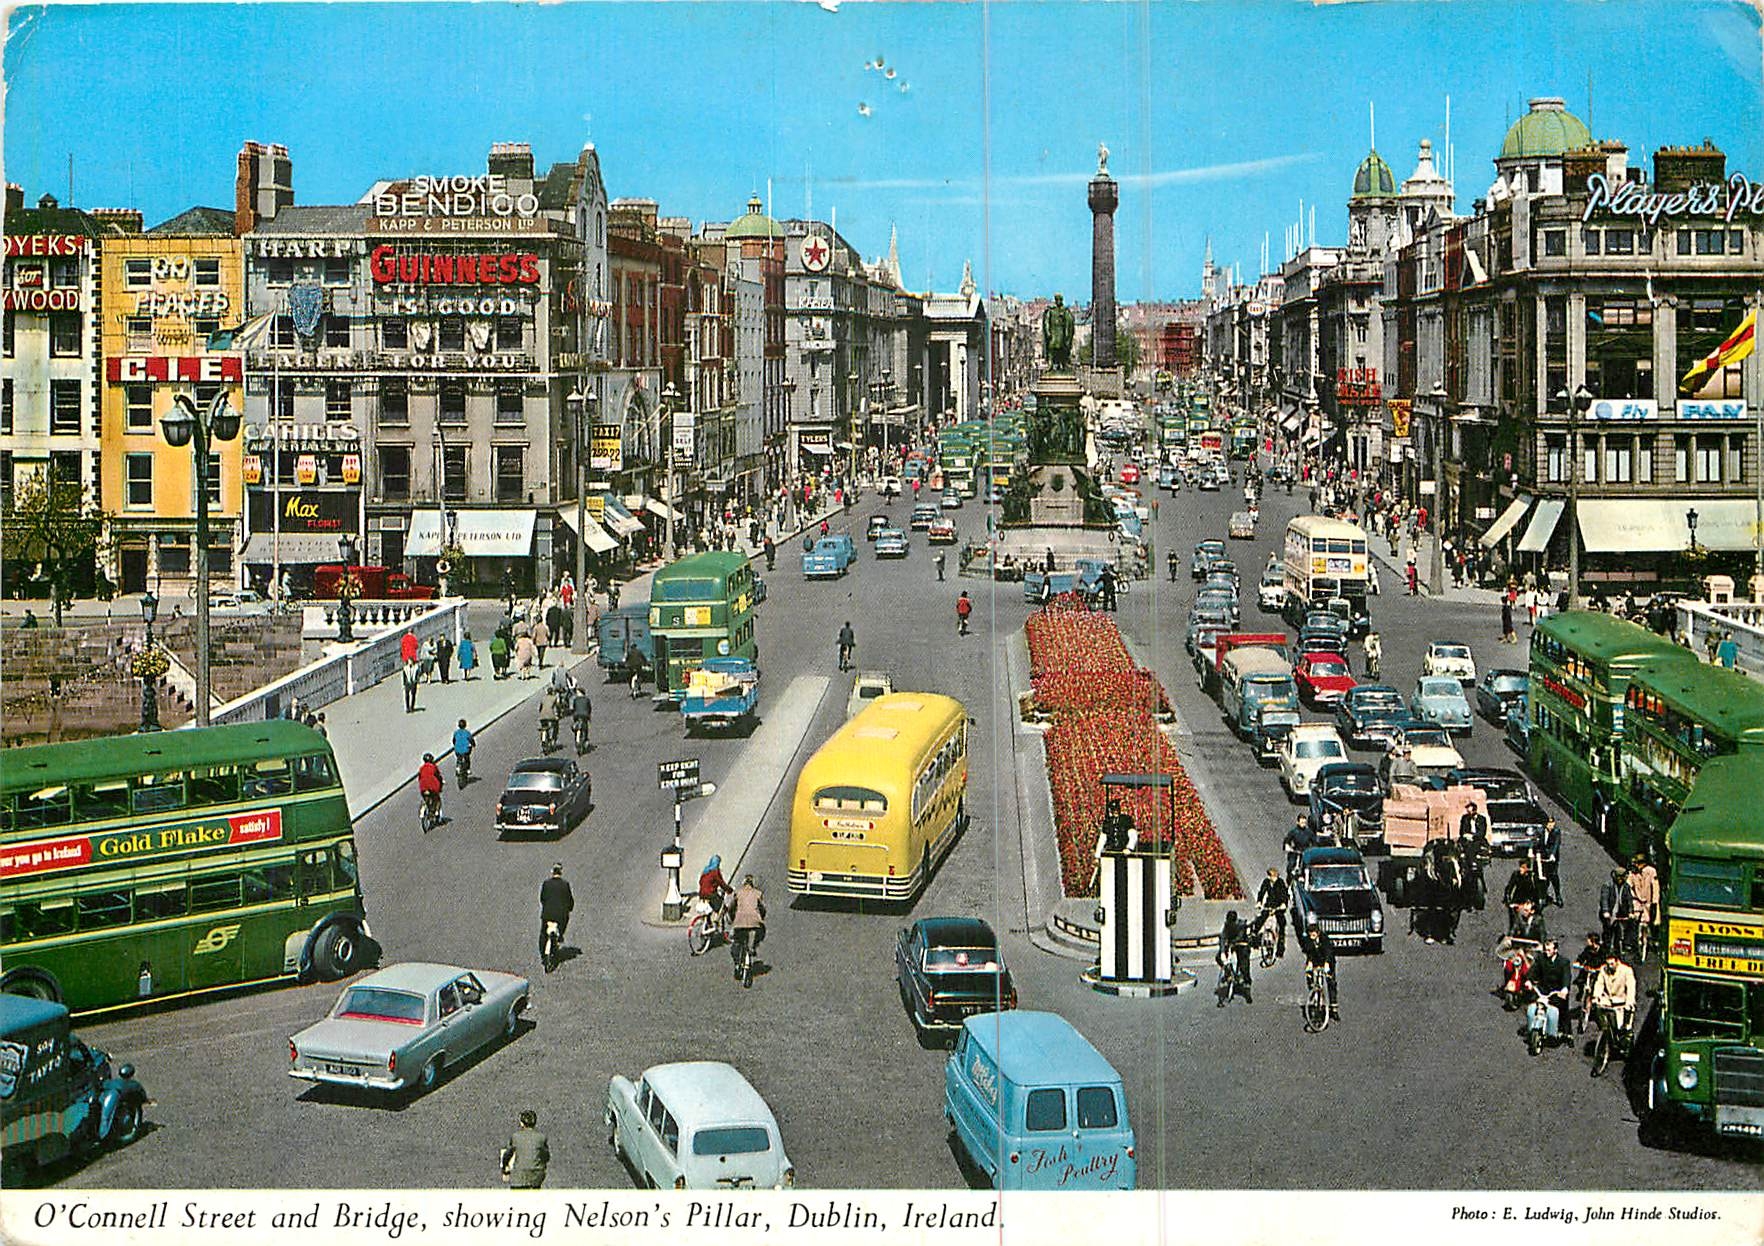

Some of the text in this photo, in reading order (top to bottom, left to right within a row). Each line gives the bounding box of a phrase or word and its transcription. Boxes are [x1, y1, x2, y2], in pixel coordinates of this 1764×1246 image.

[415, 174, 506, 193] SMOKE
[376, 193, 539, 216] BENDIGO
[379, 219, 416, 231] KAPP
[442, 219, 511, 231] PETERSON
[370, 244, 541, 285] GUINNESS
[393, 298, 516, 316] IS GOOD
[121, 358, 234, 381] C.I.E.
[465, 355, 516, 368] YOU
[1621, 404, 1648, 421] Fly
[285, 496, 319, 518] Max
[419, 531, 441, 540] KAP
[100, 826, 225, 857] Gold Flake
[1698, 924, 1755, 935] LYONS
